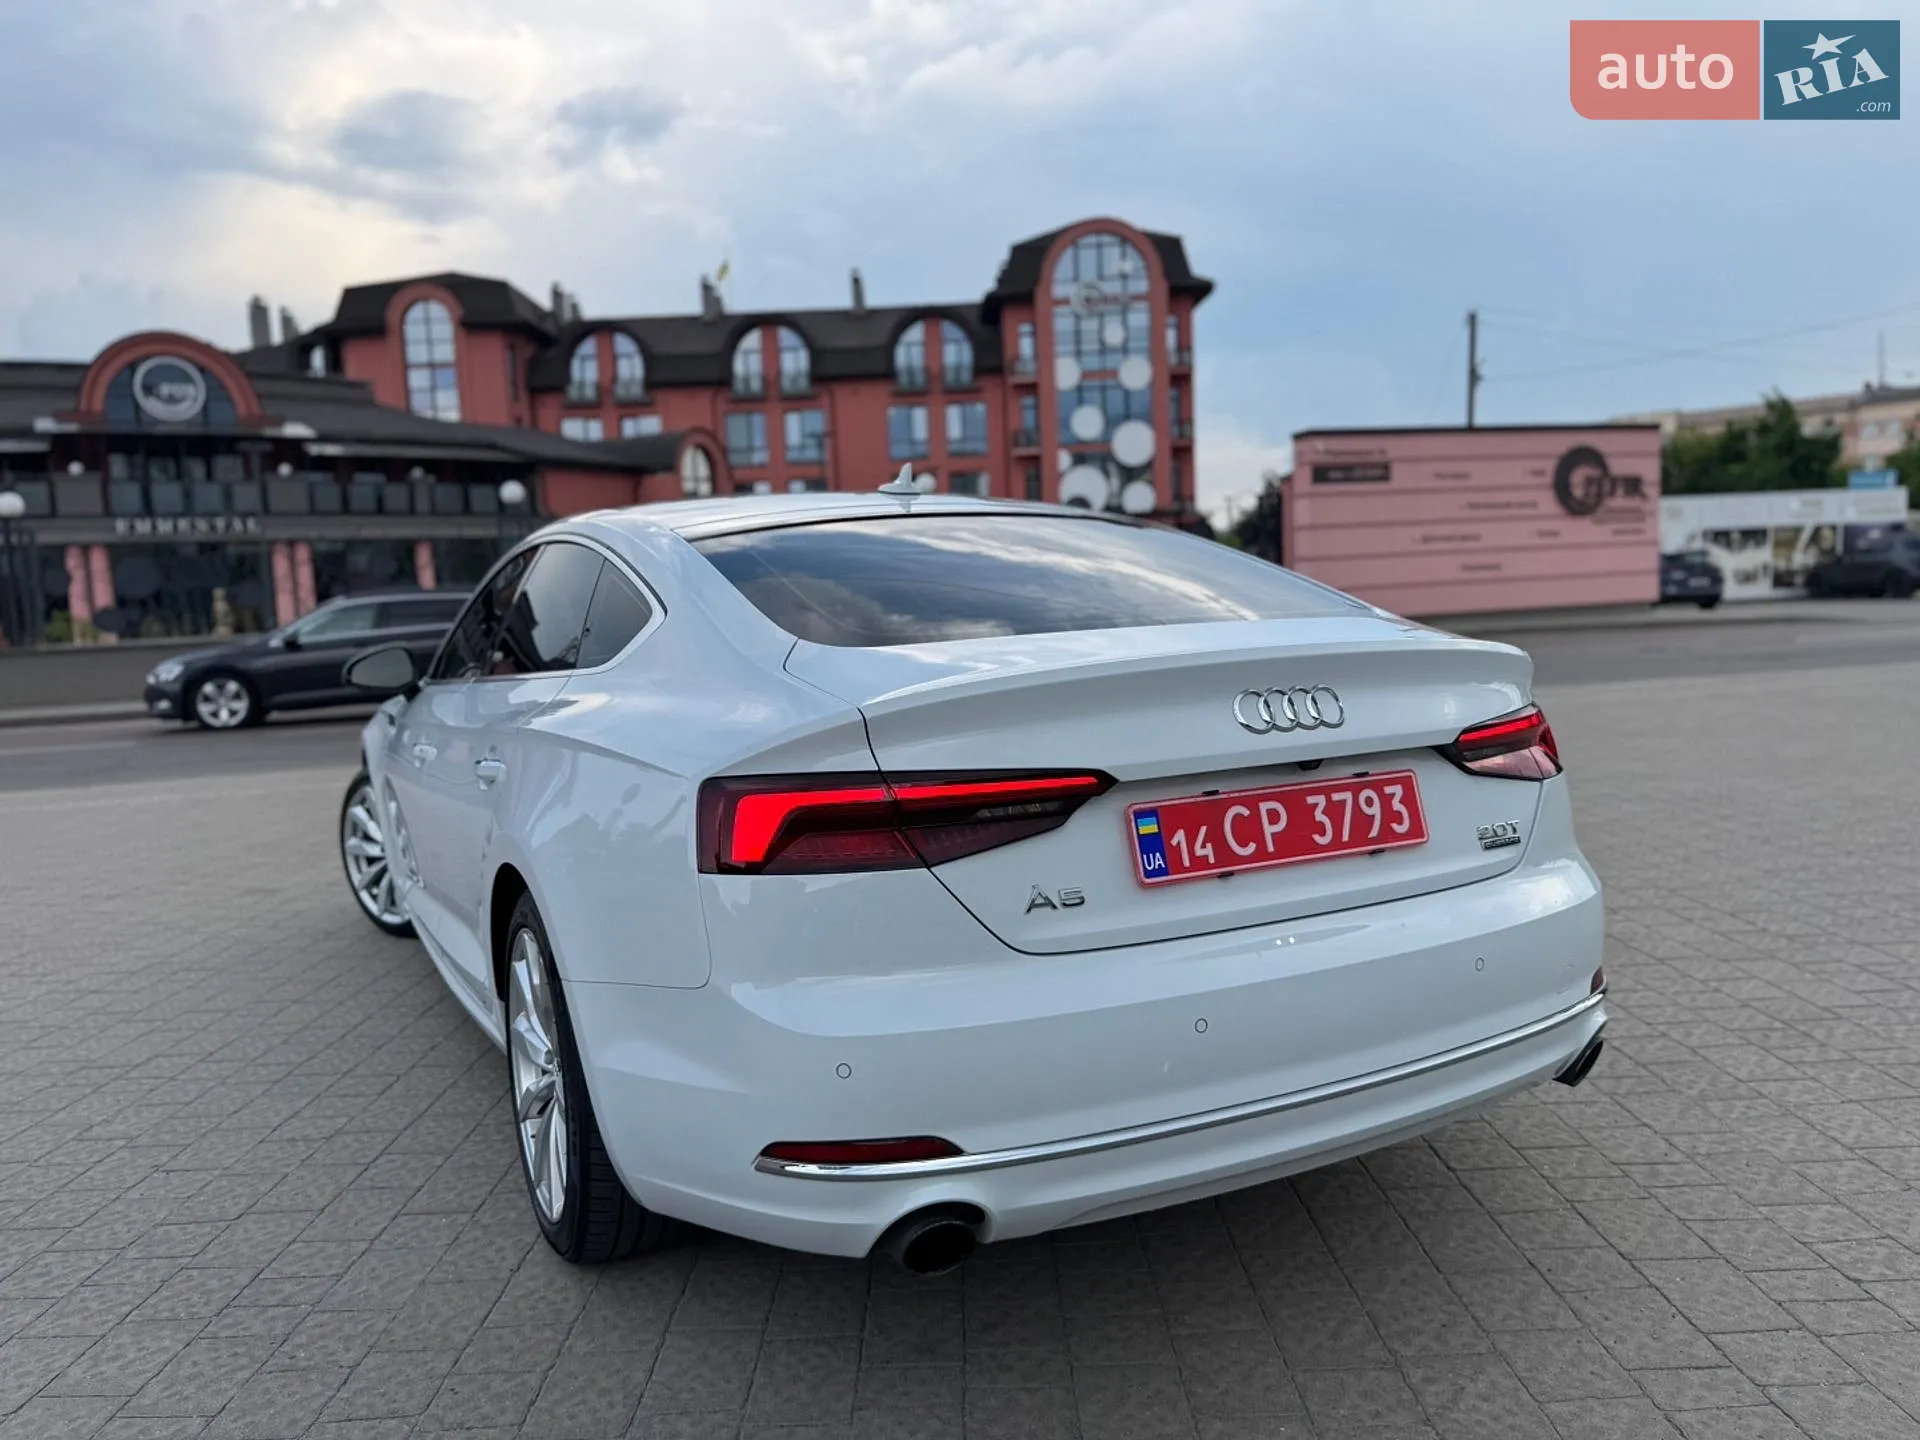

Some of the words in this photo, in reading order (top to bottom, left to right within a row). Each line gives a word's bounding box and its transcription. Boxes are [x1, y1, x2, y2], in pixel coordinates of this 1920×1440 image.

[1170, 826, 1215, 868] 14
[1223, 800, 1288, 856] CP
[1306, 784, 1411, 846] 3793
[1142, 853, 1166, 870] UA
[1025, 884, 1086, 915] A5
